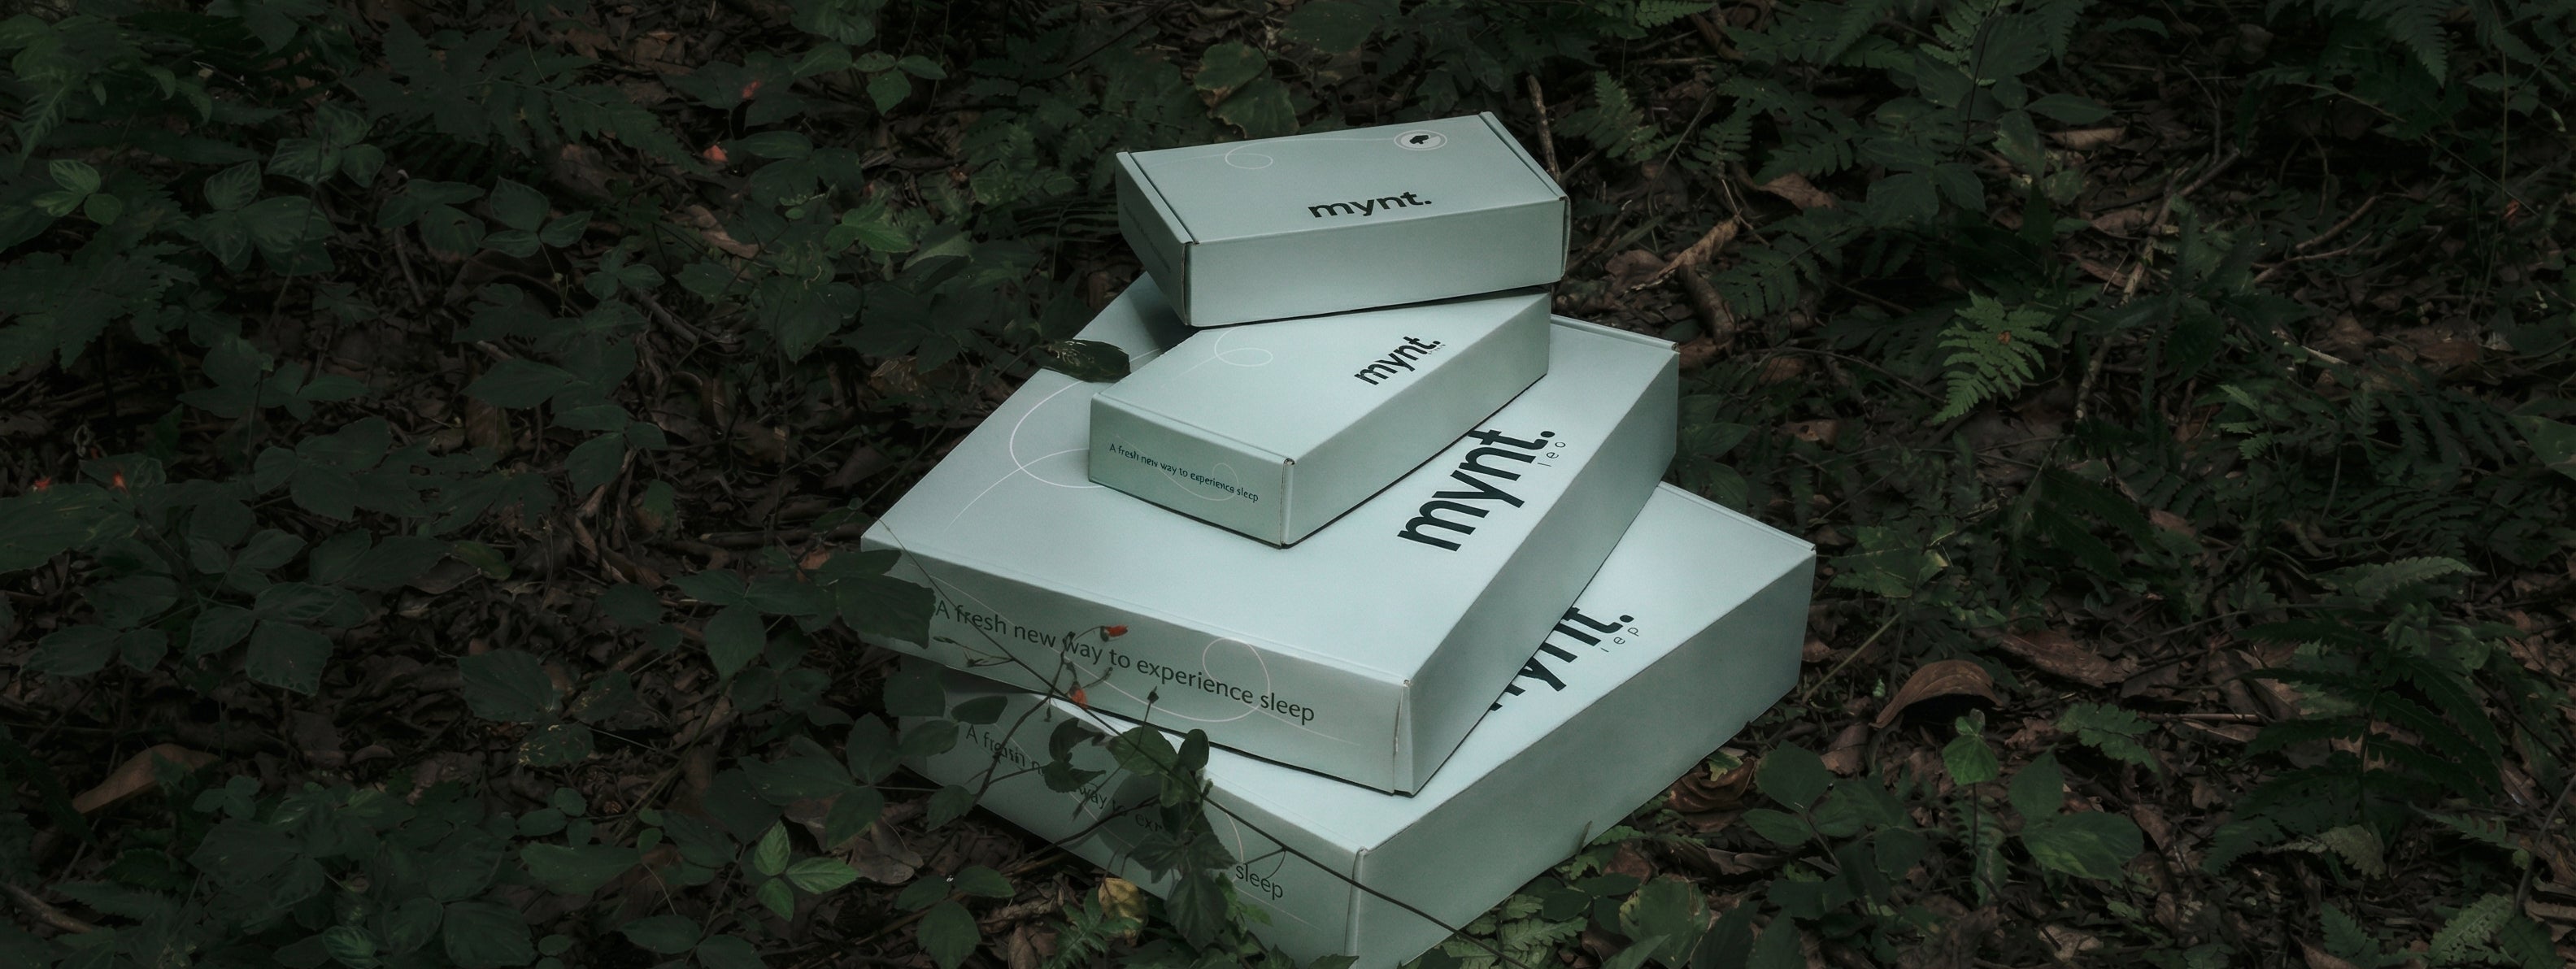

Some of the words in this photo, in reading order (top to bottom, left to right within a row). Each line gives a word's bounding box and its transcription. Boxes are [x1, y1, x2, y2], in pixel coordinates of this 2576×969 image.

[1308, 191, 1433, 218] mynt.
[1354, 336, 1441, 385] mynt.
[1109, 443, 1116, 453] A
[1118, 445, 1139, 461] fresh
[1160, 463, 1178, 476] way
[1179, 467, 1189, 477] to
[1397, 429, 1556, 552] mynt.
[935, 600, 950, 619] A
[955, 605, 1007, 634] fresh
[1014, 624, 1056, 648] new
[1062, 637, 1103, 665] way
[1109, 649, 1131, 668] to
[1137, 659, 1254, 705] experience
[1260, 693, 1315, 725] sleep
[965, 724, 978, 745] A
[1236, 863, 1283, 901] sleep
